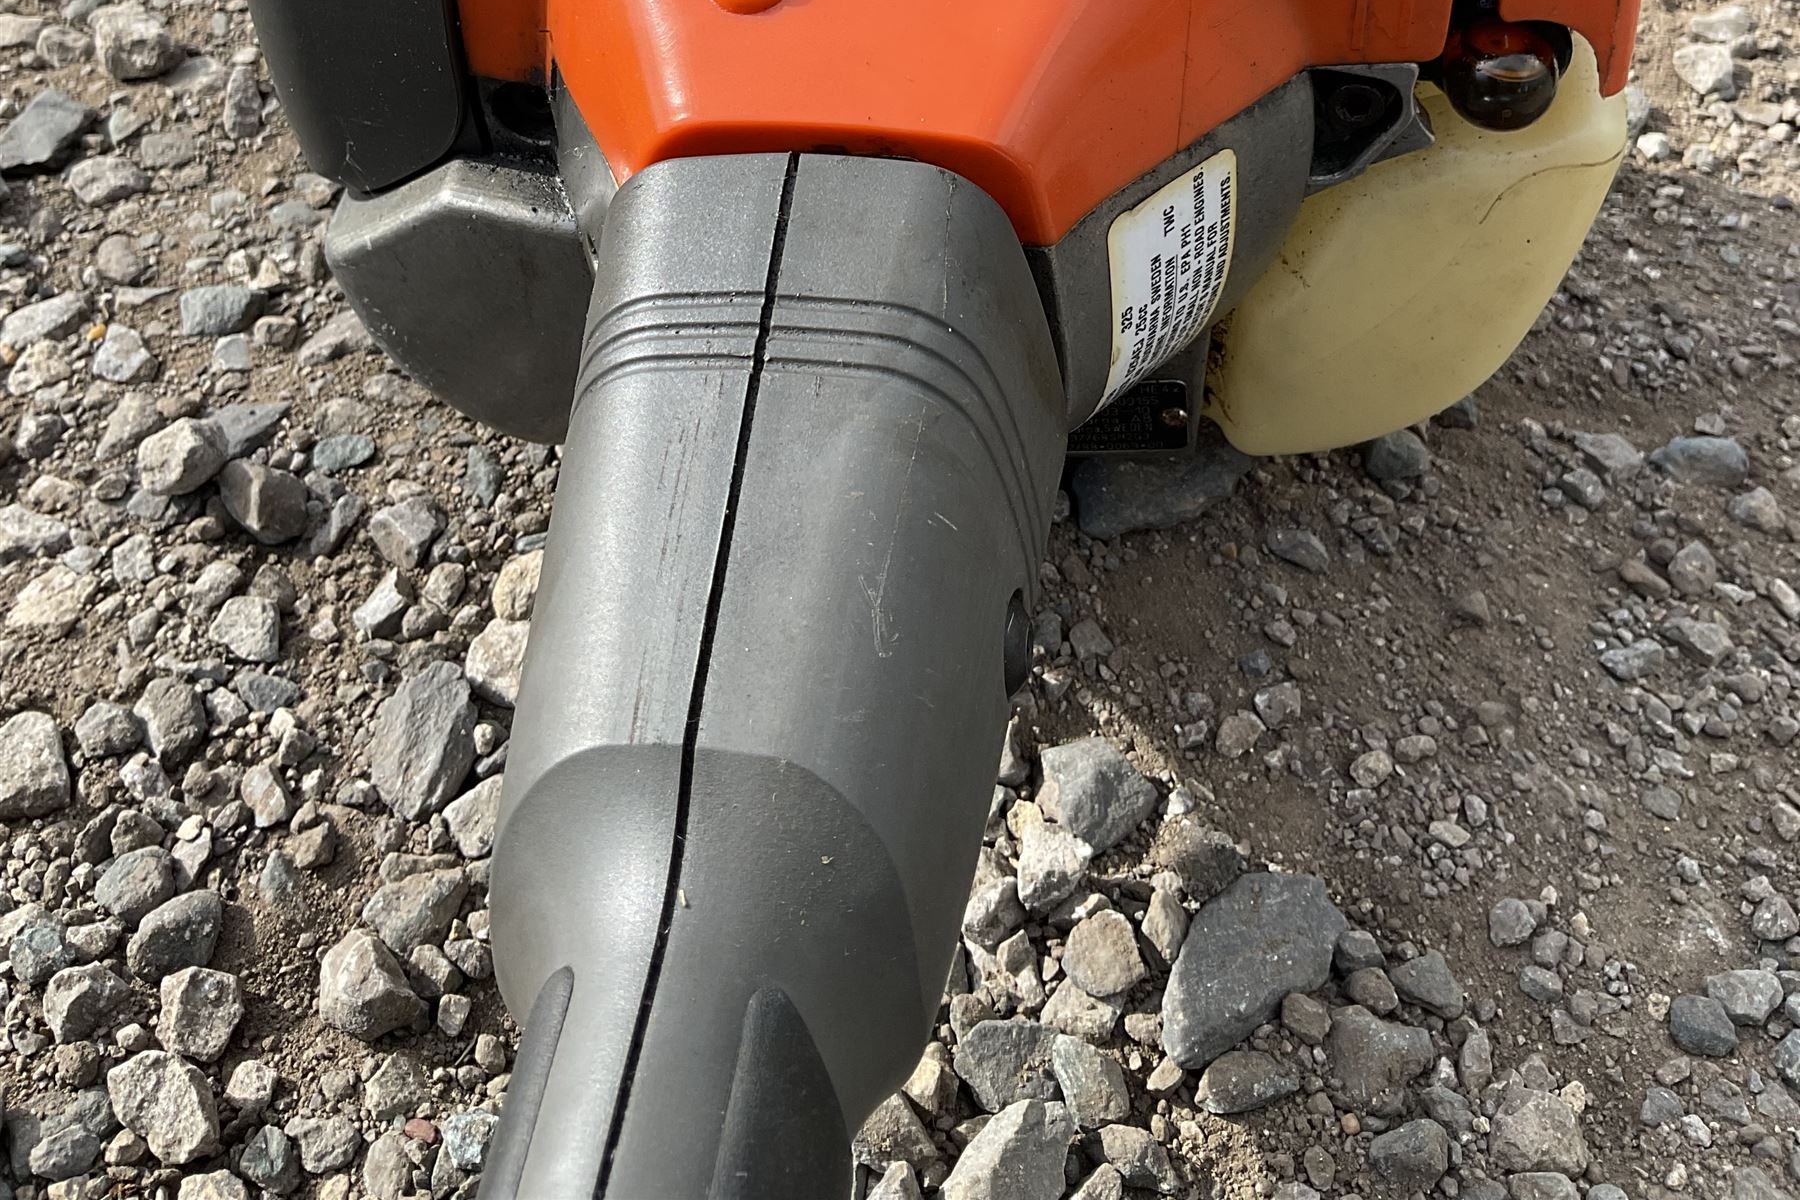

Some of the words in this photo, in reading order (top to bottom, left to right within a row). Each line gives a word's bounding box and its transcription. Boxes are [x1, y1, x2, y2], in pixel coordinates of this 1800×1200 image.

[1194, 166, 1205, 228] ENGINES.
[1163, 204, 1175, 238] TWC
[1218, 171, 1231, 259] ADJUSTMENTS.
[1181, 223, 1192, 249] PH1
[1194, 226, 1205, 260] ROAD
[1206, 221, 1218, 248] FOR
[1180, 248, 1192, 275] EPA
[1201, 247, 1217, 294] MANUAL
[1214, 258, 1226, 282] AND
[1150, 253, 1162, 305] SWEDEN
[1160, 256, 1175, 332] INFORMATION
[1178, 277, 1190, 304] U.S.
[1191, 265, 1203, 292] NON
[1121, 305, 1134, 334] 325
[1134, 303, 1148, 336] 25cc
